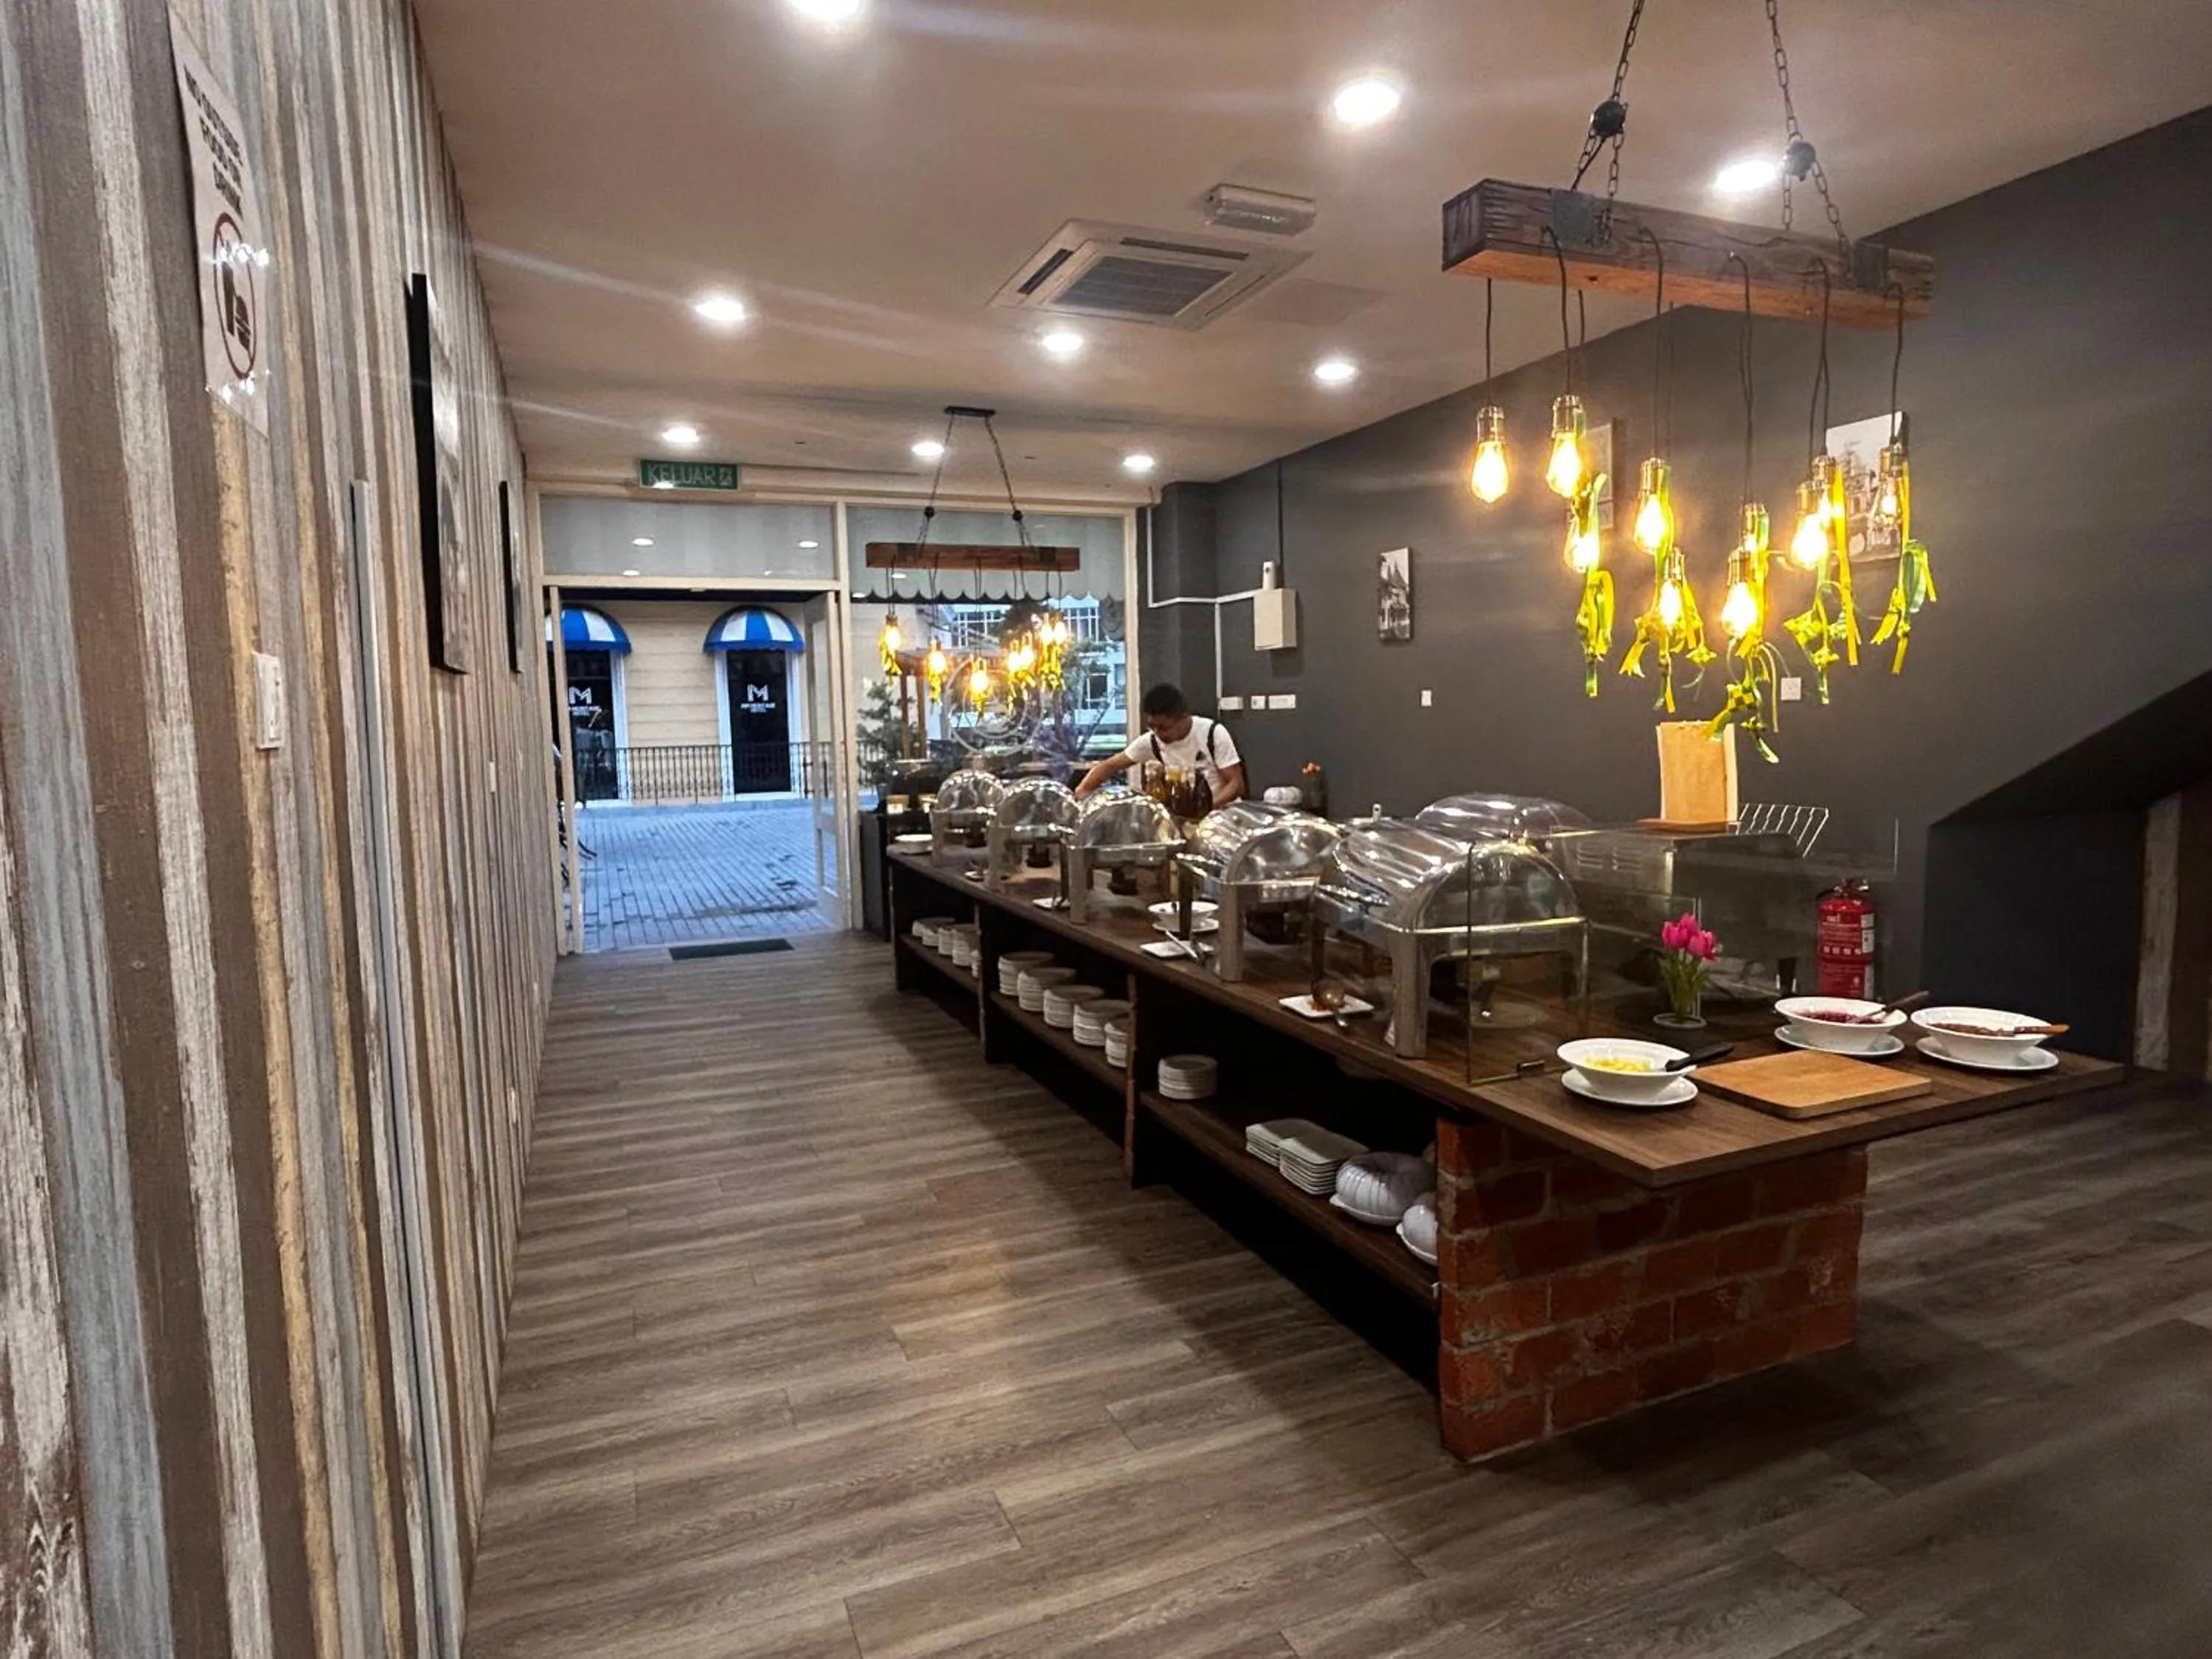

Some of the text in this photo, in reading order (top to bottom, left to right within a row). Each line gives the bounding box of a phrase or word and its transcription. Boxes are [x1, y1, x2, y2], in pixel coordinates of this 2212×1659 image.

[648, 464, 717, 486] KELUAR
[568, 686, 592, 704] M
[747, 684, 768, 701] M
